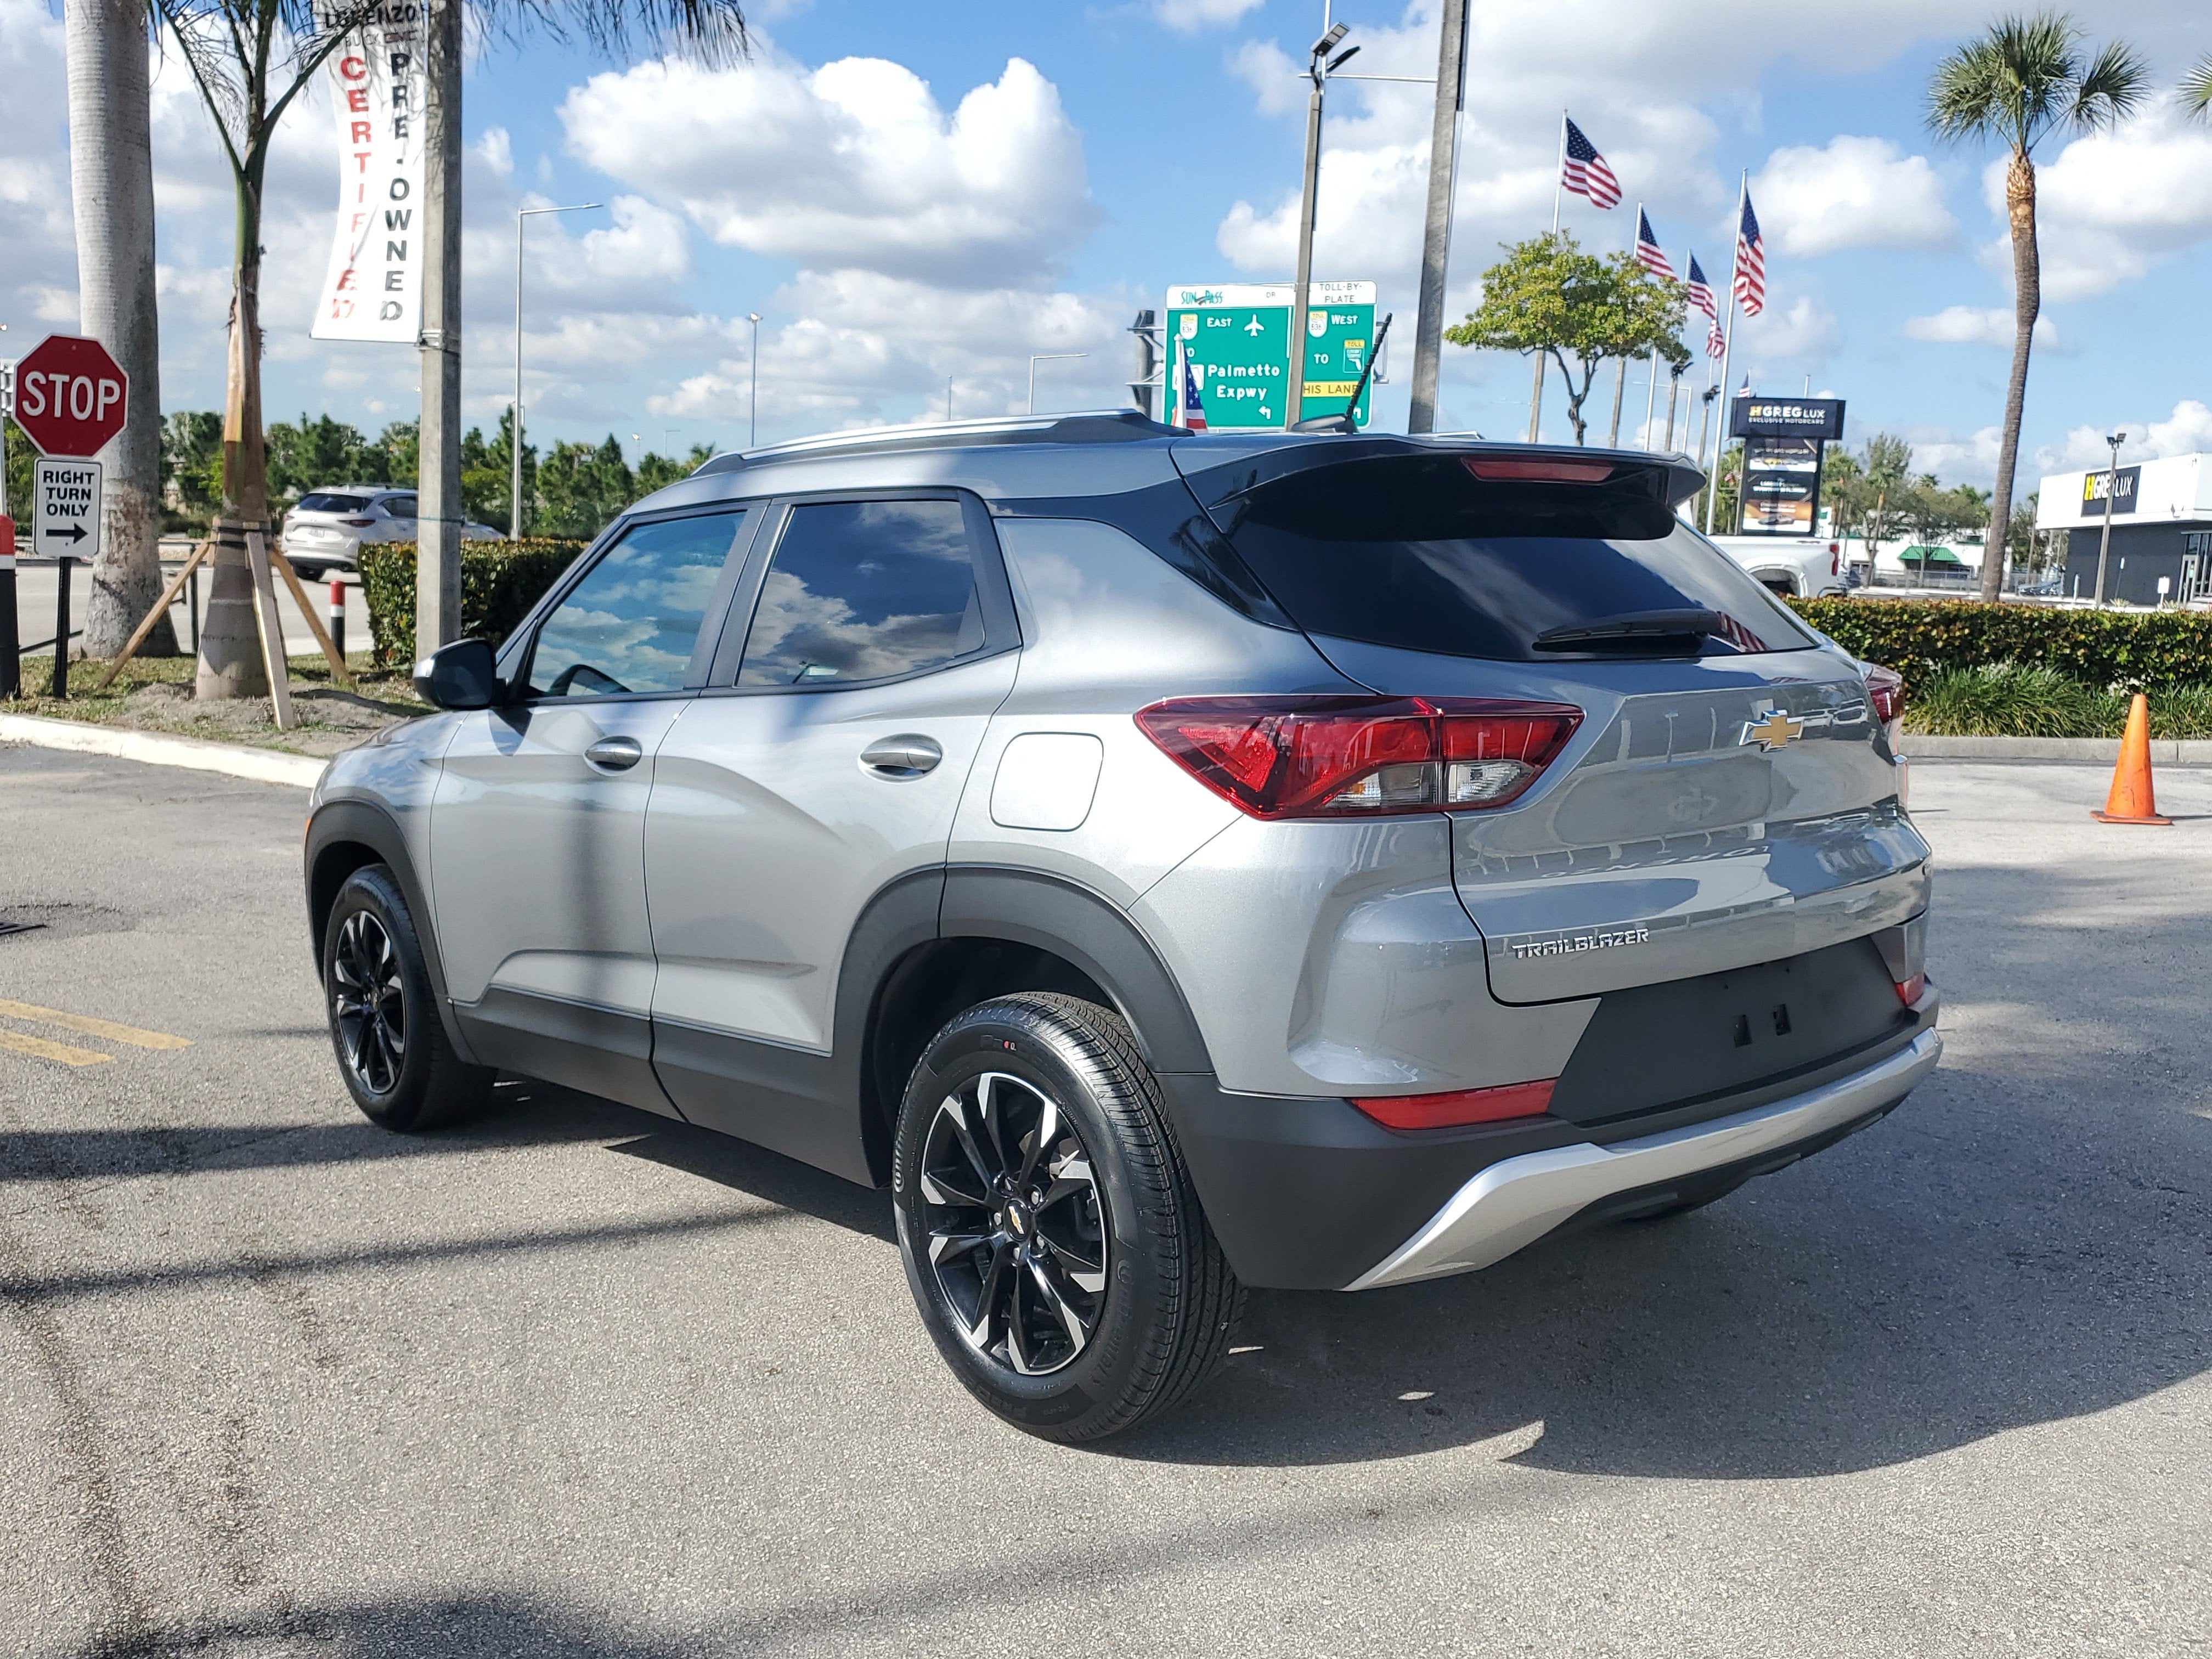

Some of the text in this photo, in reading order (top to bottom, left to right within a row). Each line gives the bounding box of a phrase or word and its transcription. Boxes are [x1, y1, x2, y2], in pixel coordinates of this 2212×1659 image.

[326, 4, 416, 27] LOENZO
[345, 33, 381, 47] BUCK
[331, 57, 371, 319] CERTIFIED
[1207, 317, 1232, 328] EAST
[1331, 314, 1358, 325] WEST
[1314, 353, 1329, 364] TO
[1207, 364, 1280, 377] Palmetto
[22, 370, 121, 421] STOP
[1217, 384, 1267, 401] Expwy
[1303, 385, 1321, 394] HIS
[1749, 405, 1826, 419] HGREG LUX
[43, 470, 95, 485] RIGHT
[46, 487, 92, 501] TURN
[2084, 475, 2133, 500] HGRE LUX
[46, 503, 89, 517] ONLY
[1512, 928, 1649, 959] TRAILBLAZER
